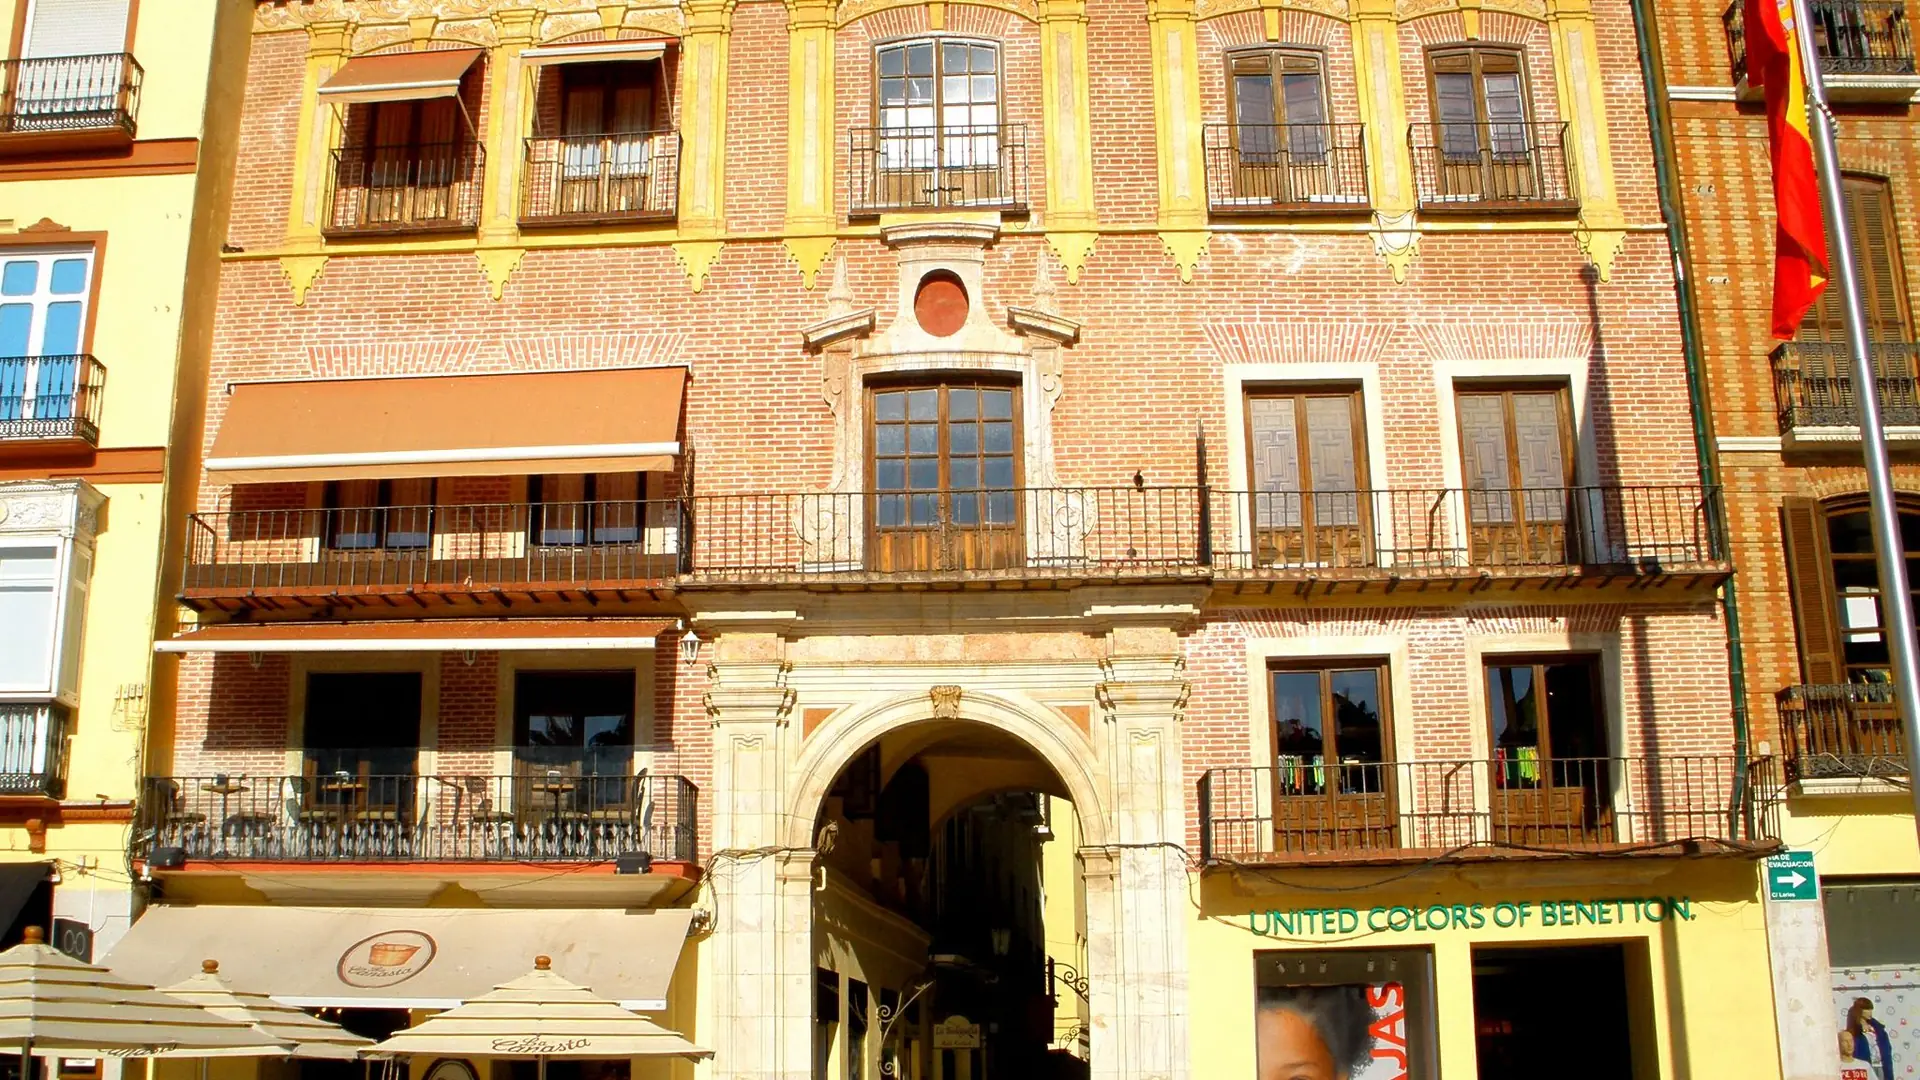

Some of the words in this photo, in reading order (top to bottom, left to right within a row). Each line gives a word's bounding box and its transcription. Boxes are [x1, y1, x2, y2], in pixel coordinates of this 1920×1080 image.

[1250, 907, 1359, 936] UNITED
[1367, 903, 1486, 932] COLORS
[1493, 901, 1532, 928] OF
[347, 965, 413, 978] Canasta
[1365, 981, 1410, 1080] JAS
[491, 1038, 592, 1053] Canasta
